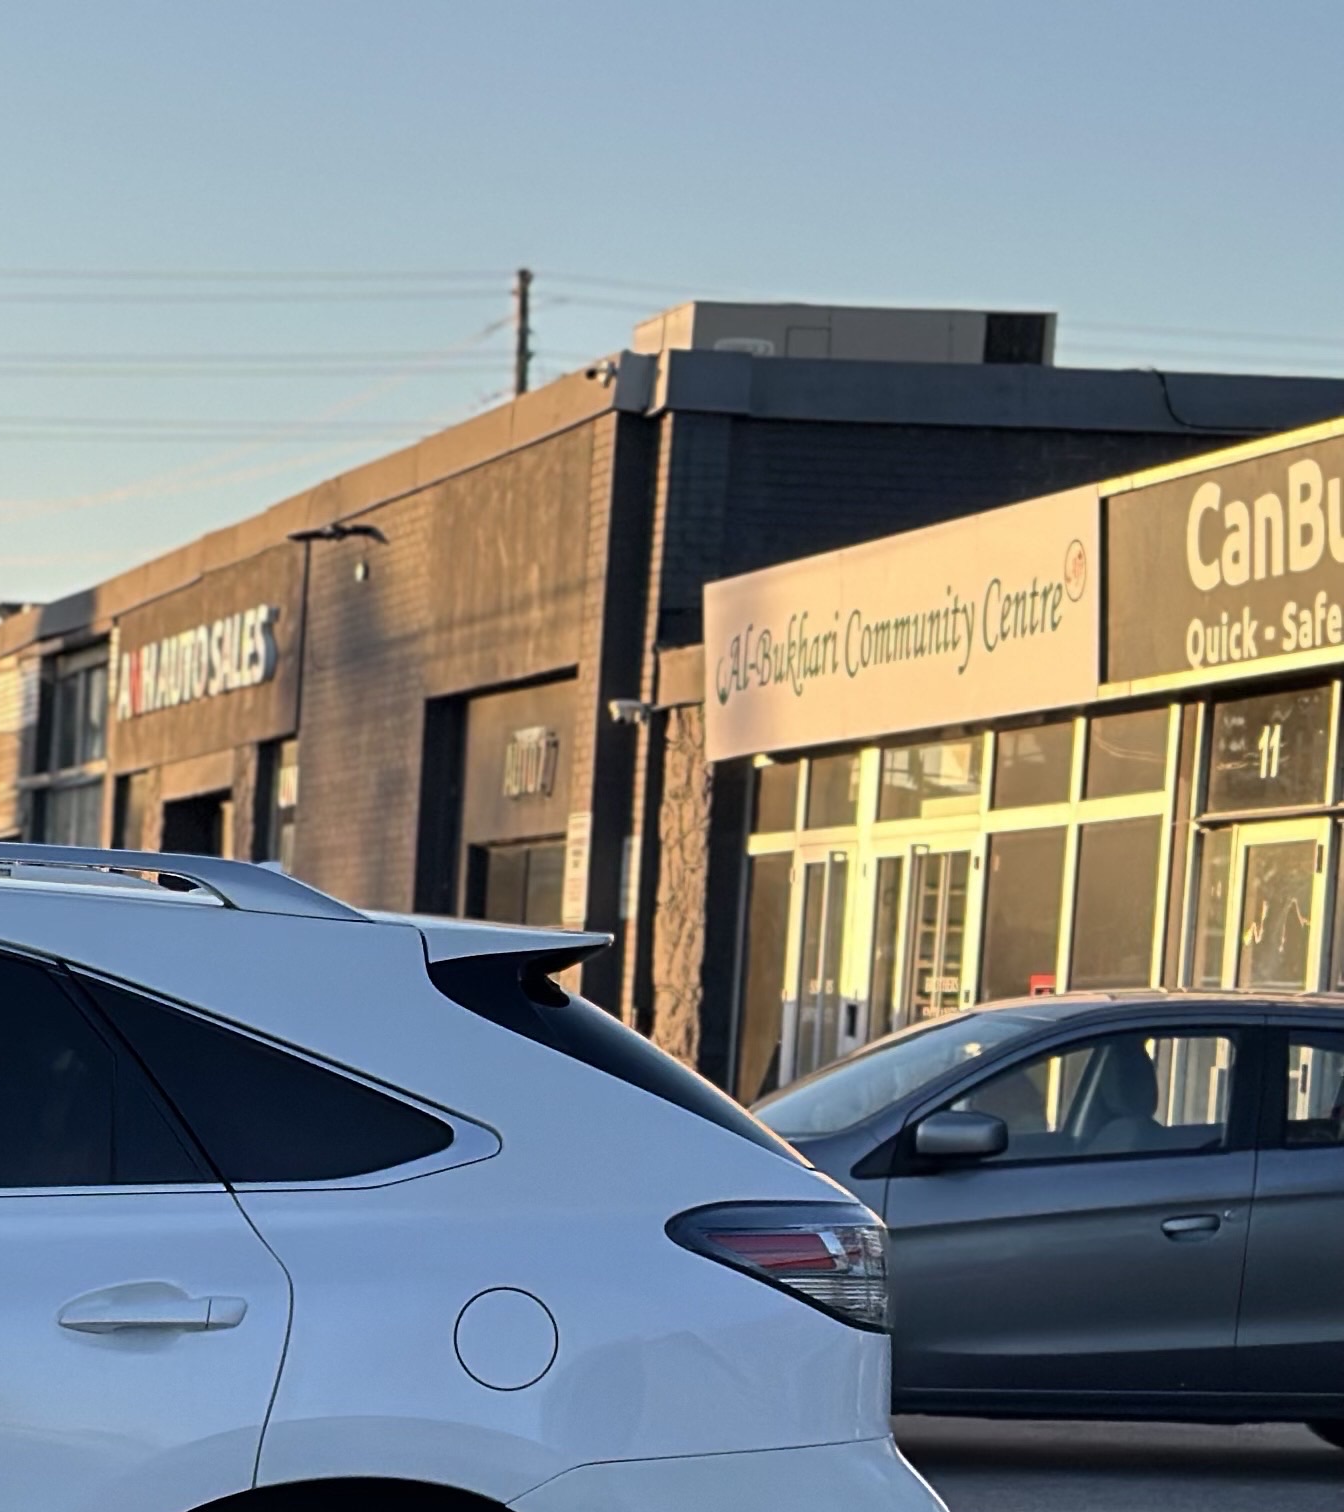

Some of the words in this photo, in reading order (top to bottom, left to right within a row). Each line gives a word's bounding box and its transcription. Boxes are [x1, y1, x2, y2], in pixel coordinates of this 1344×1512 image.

[208, 604, 272, 697] SALES
[716, 611, 839, 706] Al-Bukhari
[845, 585, 976, 678] Community
[982, 576, 1063, 653] Centre
[1186, 606, 1259, 670] Quick
[1282, 590, 1343, 652] Safe
[1258, 724, 1281, 779] 11
